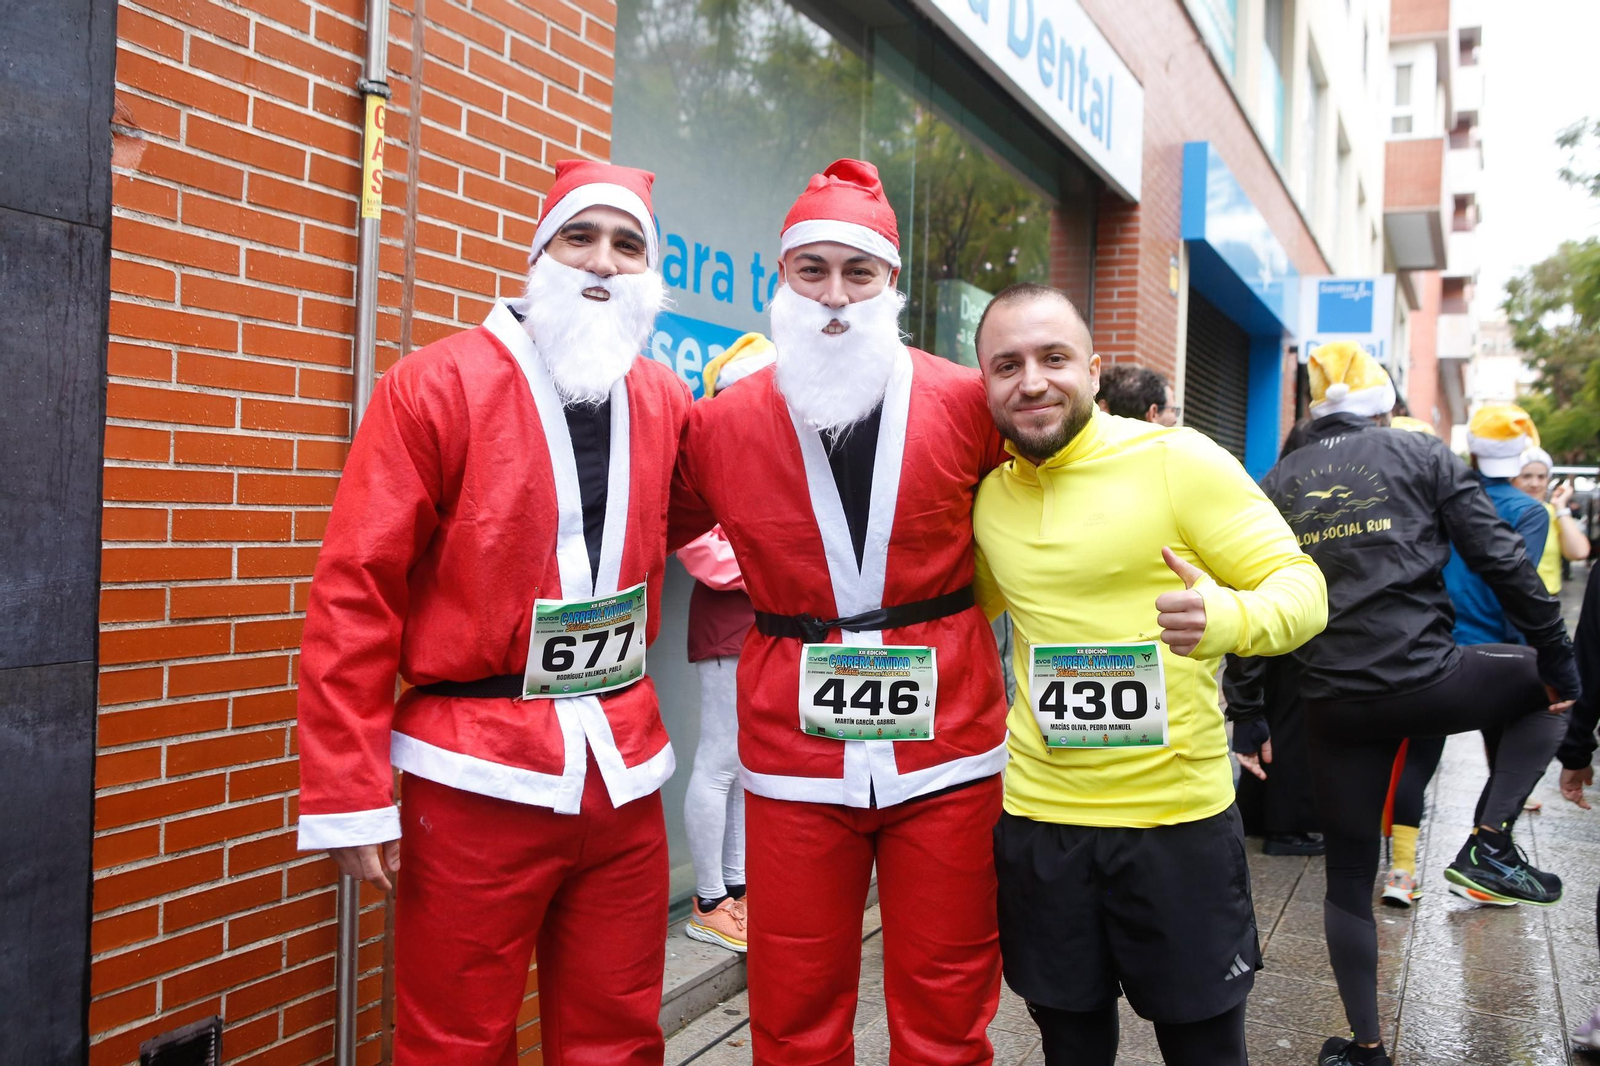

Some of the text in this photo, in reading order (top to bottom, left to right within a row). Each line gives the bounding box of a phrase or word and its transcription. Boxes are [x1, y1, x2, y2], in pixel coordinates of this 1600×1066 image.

[1007, 0, 1113, 151] Dental
[371, 105, 386, 195] GAS
[654, 214, 734, 304] ara
[1296, 518, 1392, 547] LOW SOCIAL RUN
[561, 608, 603, 626] CARRERA
[542, 622, 635, 672] 677
[828, 654, 871, 669] CARRERA
[872, 656, 911, 670] NAVIDAD
[1052, 655, 1090, 670] CARRERA
[1091, 654, 1136, 670] NAVIDAD
[556, 664, 622, 681] RODRÍGUEZ VALENCIA, PABLO
[881, 670, 911, 678] ALGECIRAS
[1102, 670, 1135, 678] ALGECIRAS
[813, 678, 920, 716] 446
[1039, 680, 1148, 721] 430
[834, 717, 855, 725] MARTÍN
[855, 717, 876, 726] GARCÍA,
[1050, 722, 1132, 732] MACÍAS OLIVA, PEDRO MANUEL
